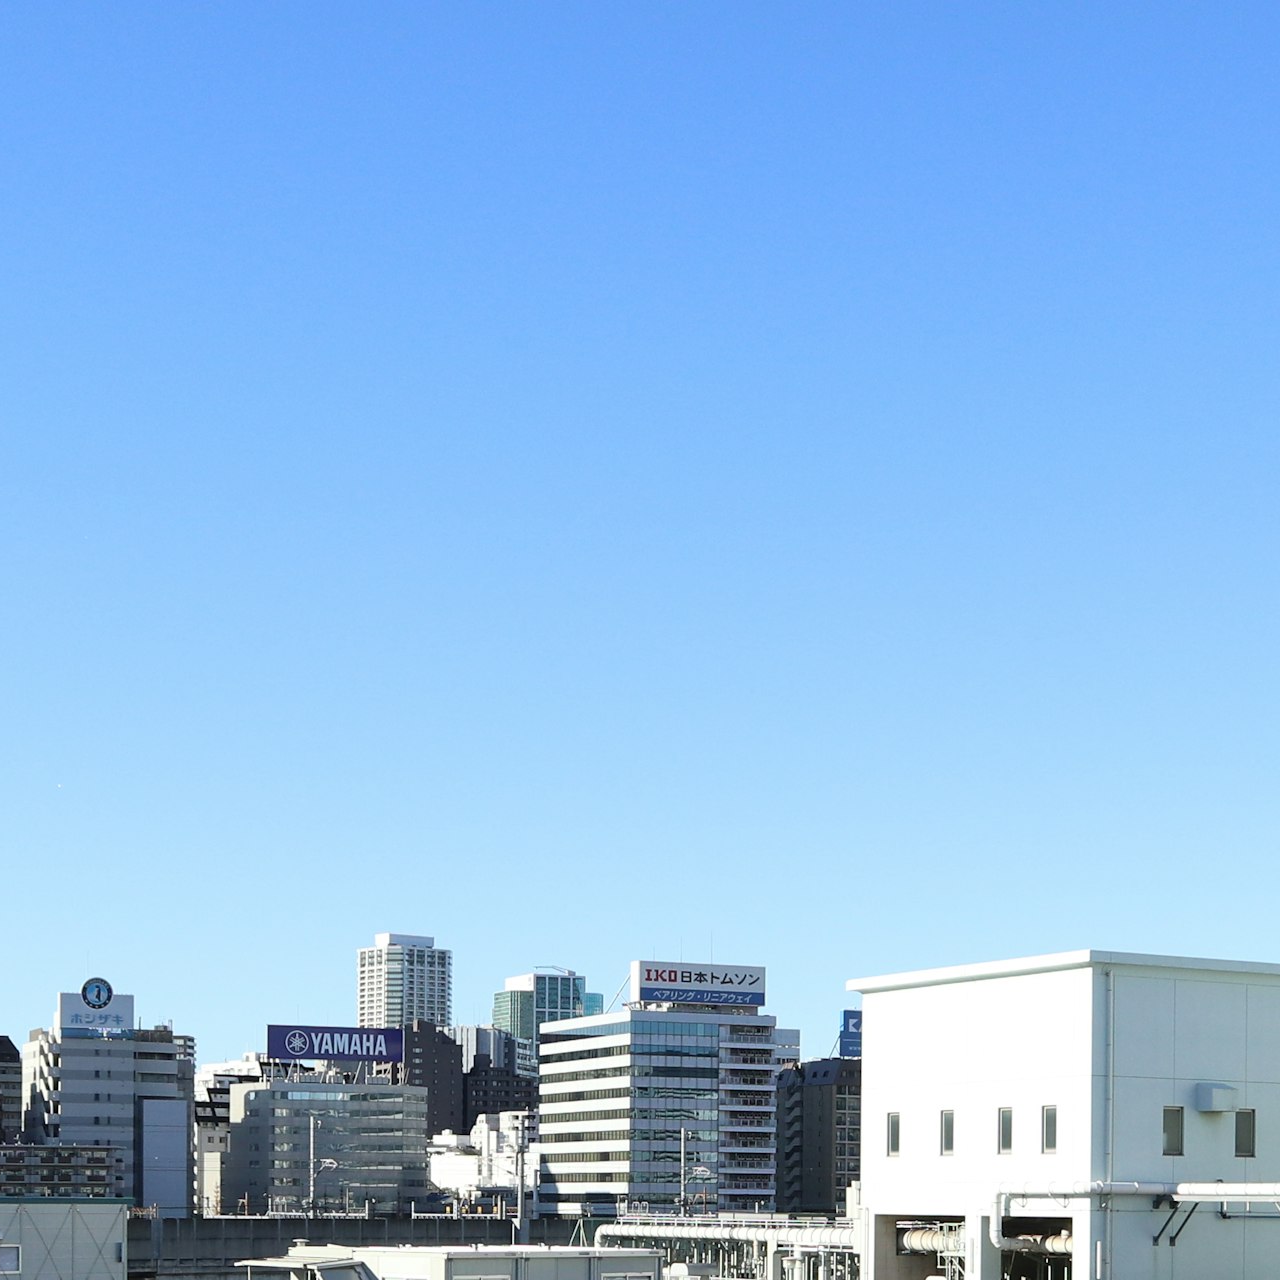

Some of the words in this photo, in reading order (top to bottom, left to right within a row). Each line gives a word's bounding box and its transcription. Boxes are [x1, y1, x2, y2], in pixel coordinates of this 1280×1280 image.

[645, 969, 677, 983] IKO
[681, 971, 760, 986] 日本トムソン
[70, 1013, 124, 1025] ホシザキ
[849, 1018, 862, 1033] K
[311, 1032, 387, 1056] YAMAHA
